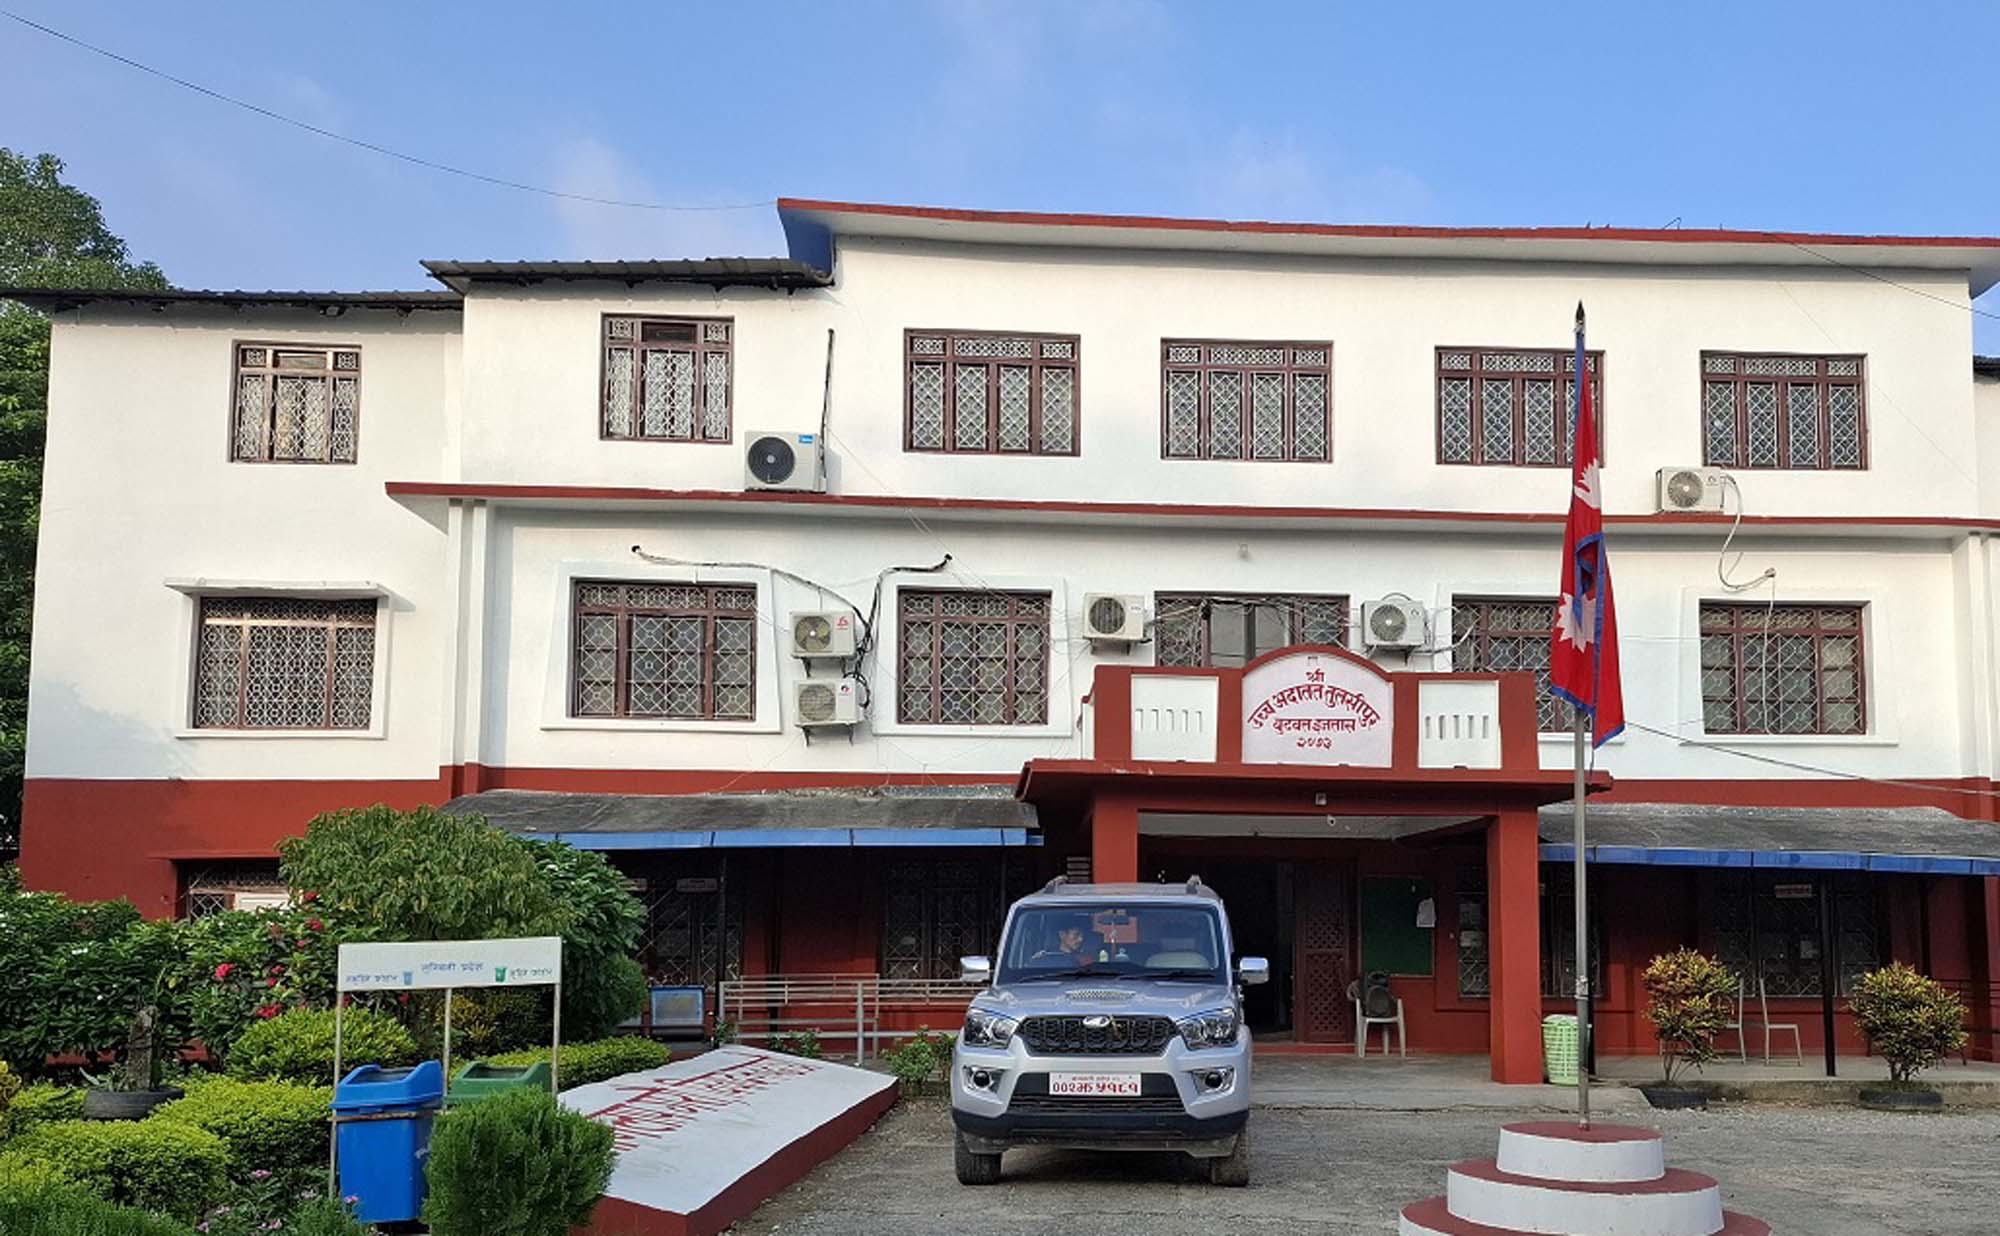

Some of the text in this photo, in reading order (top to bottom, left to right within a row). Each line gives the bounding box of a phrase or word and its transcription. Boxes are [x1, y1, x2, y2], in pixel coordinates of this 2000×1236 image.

[1305, 667, 1325, 683] श्री
[1247, 700, 1276, 728] उच्च
[1324, 685, 1381, 731] तुलसीपुर
